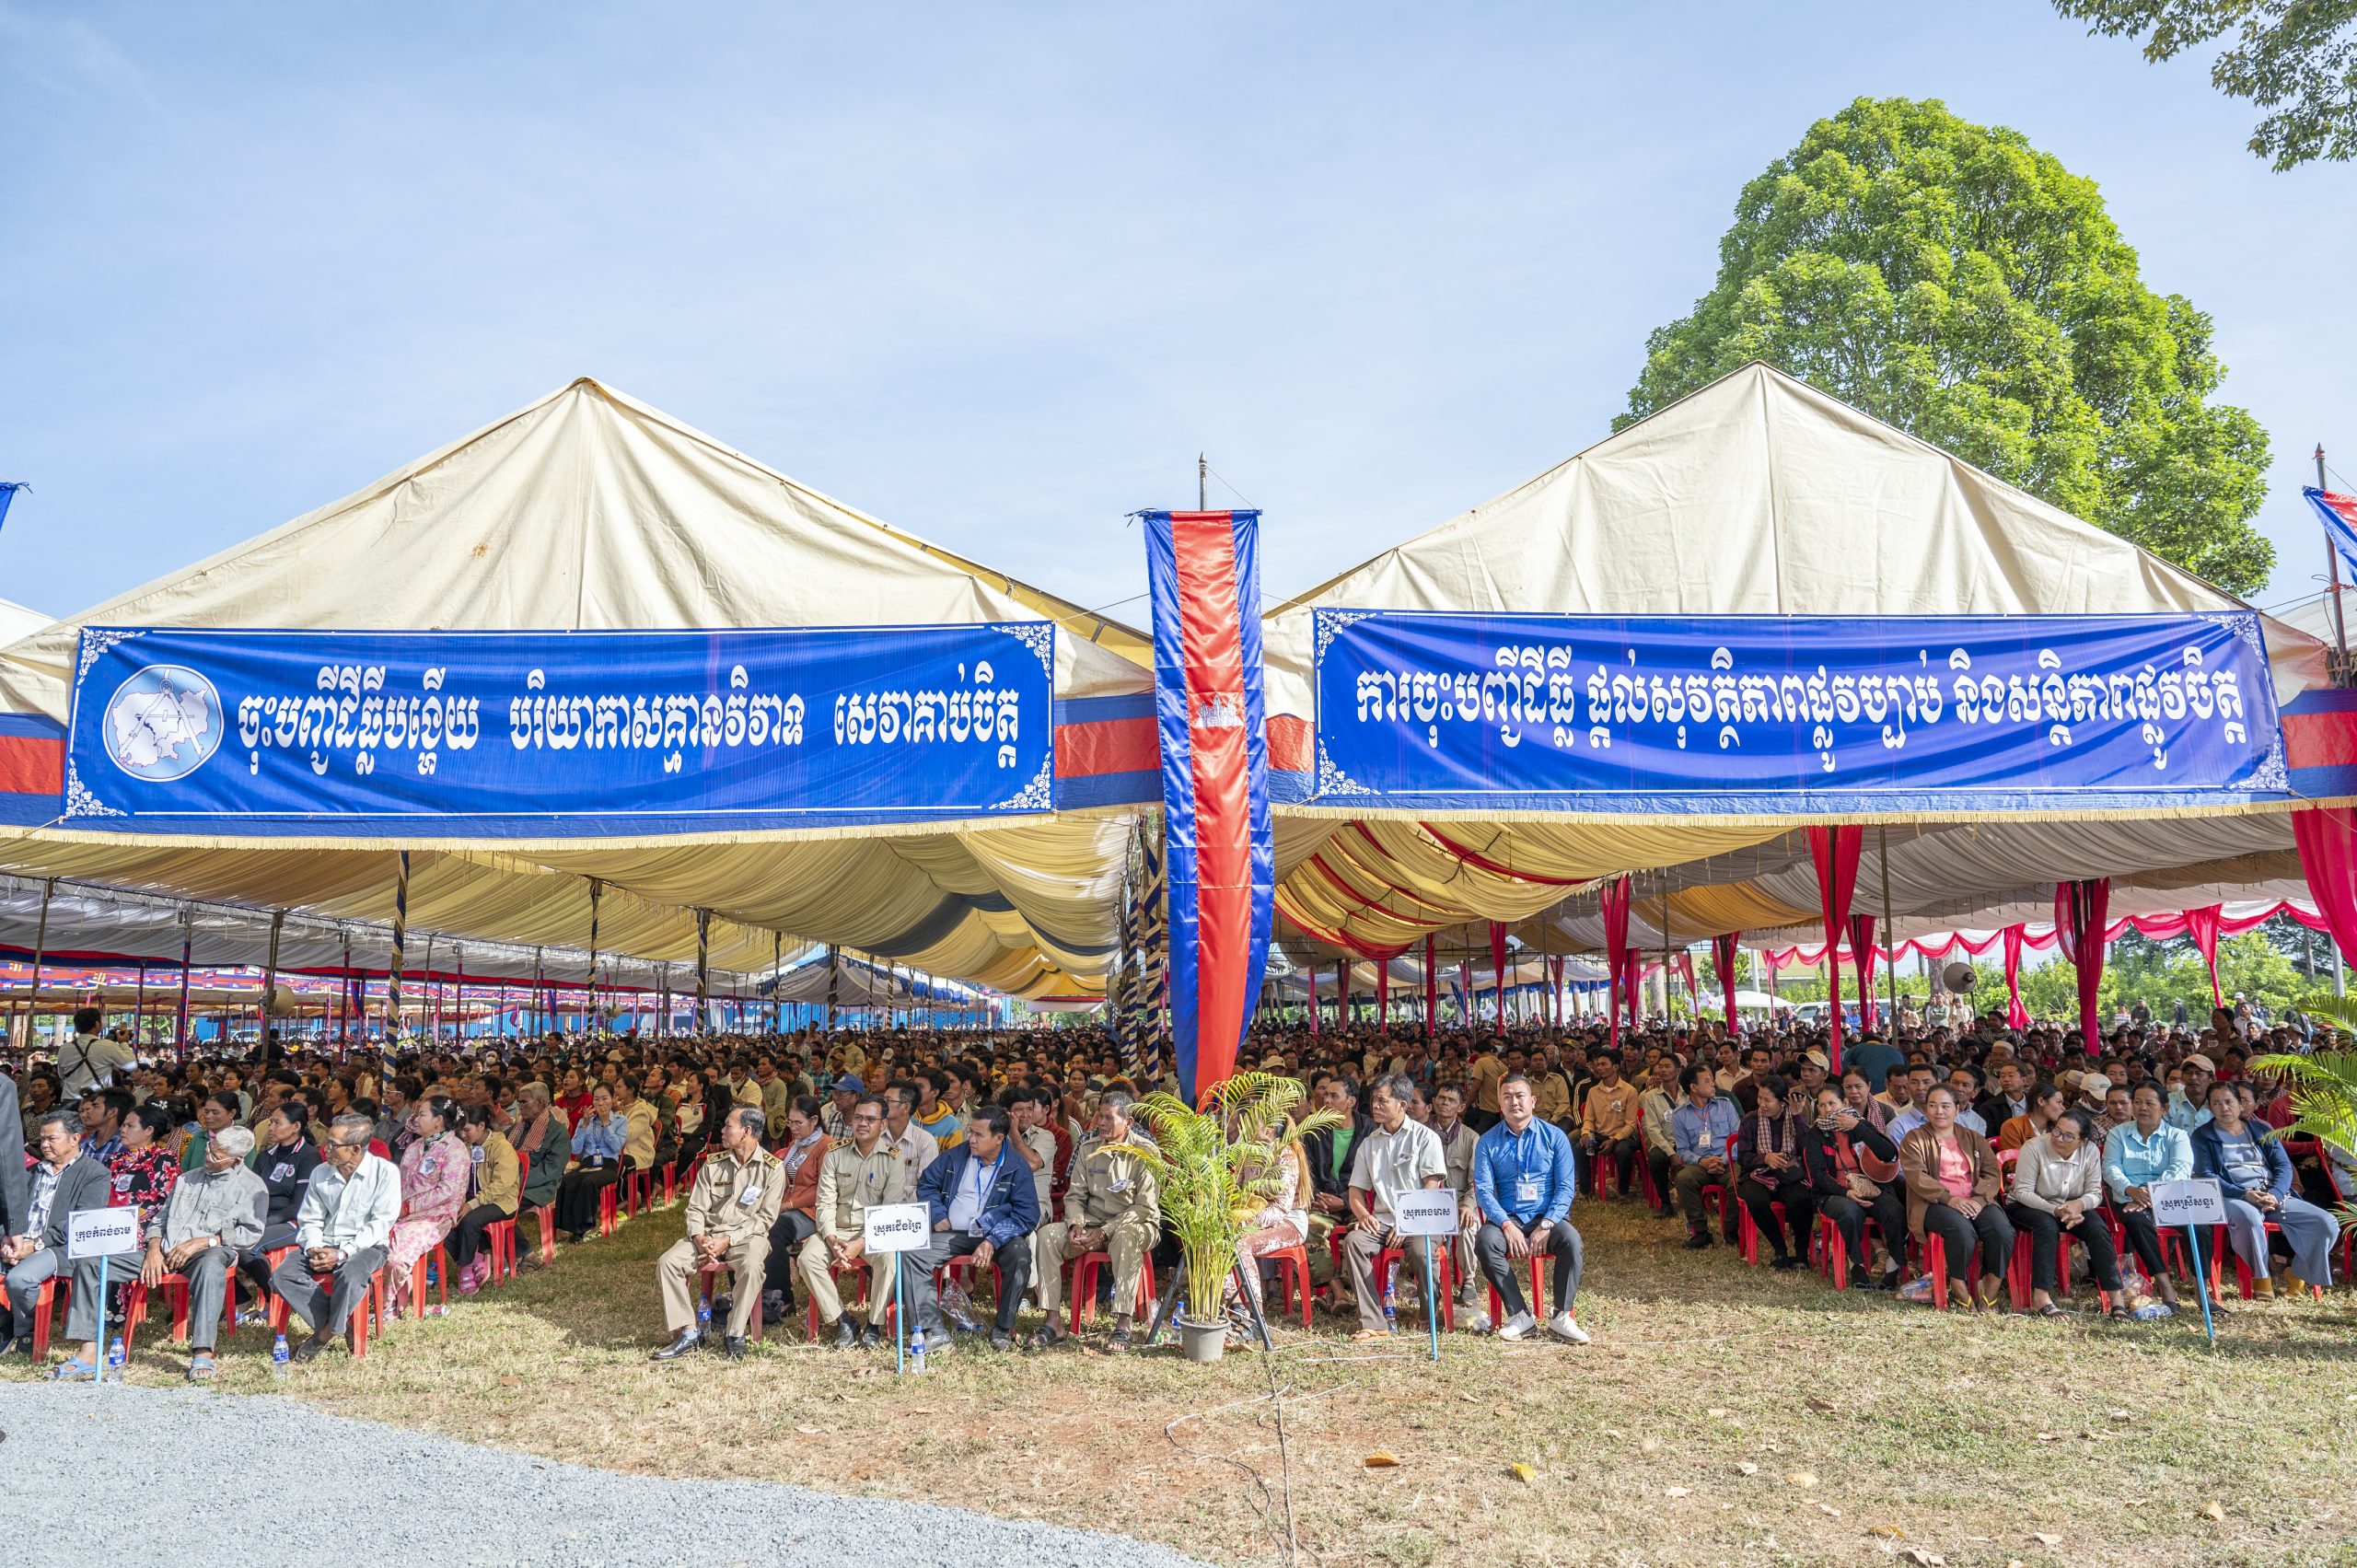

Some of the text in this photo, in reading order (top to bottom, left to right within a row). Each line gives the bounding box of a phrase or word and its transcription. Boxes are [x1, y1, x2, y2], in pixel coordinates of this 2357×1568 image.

[509, 664, 806, 773] បរិយាកាសគ្មានវិវាទ
[834, 660, 1019, 769] សេវាគាប់ចិត្ត
[1356, 645, 1575, 749] ការចុះបញ្ជីដីធ្លី
[75, 1225, 132, 1242] ក្រុងកំពង់ចាម
